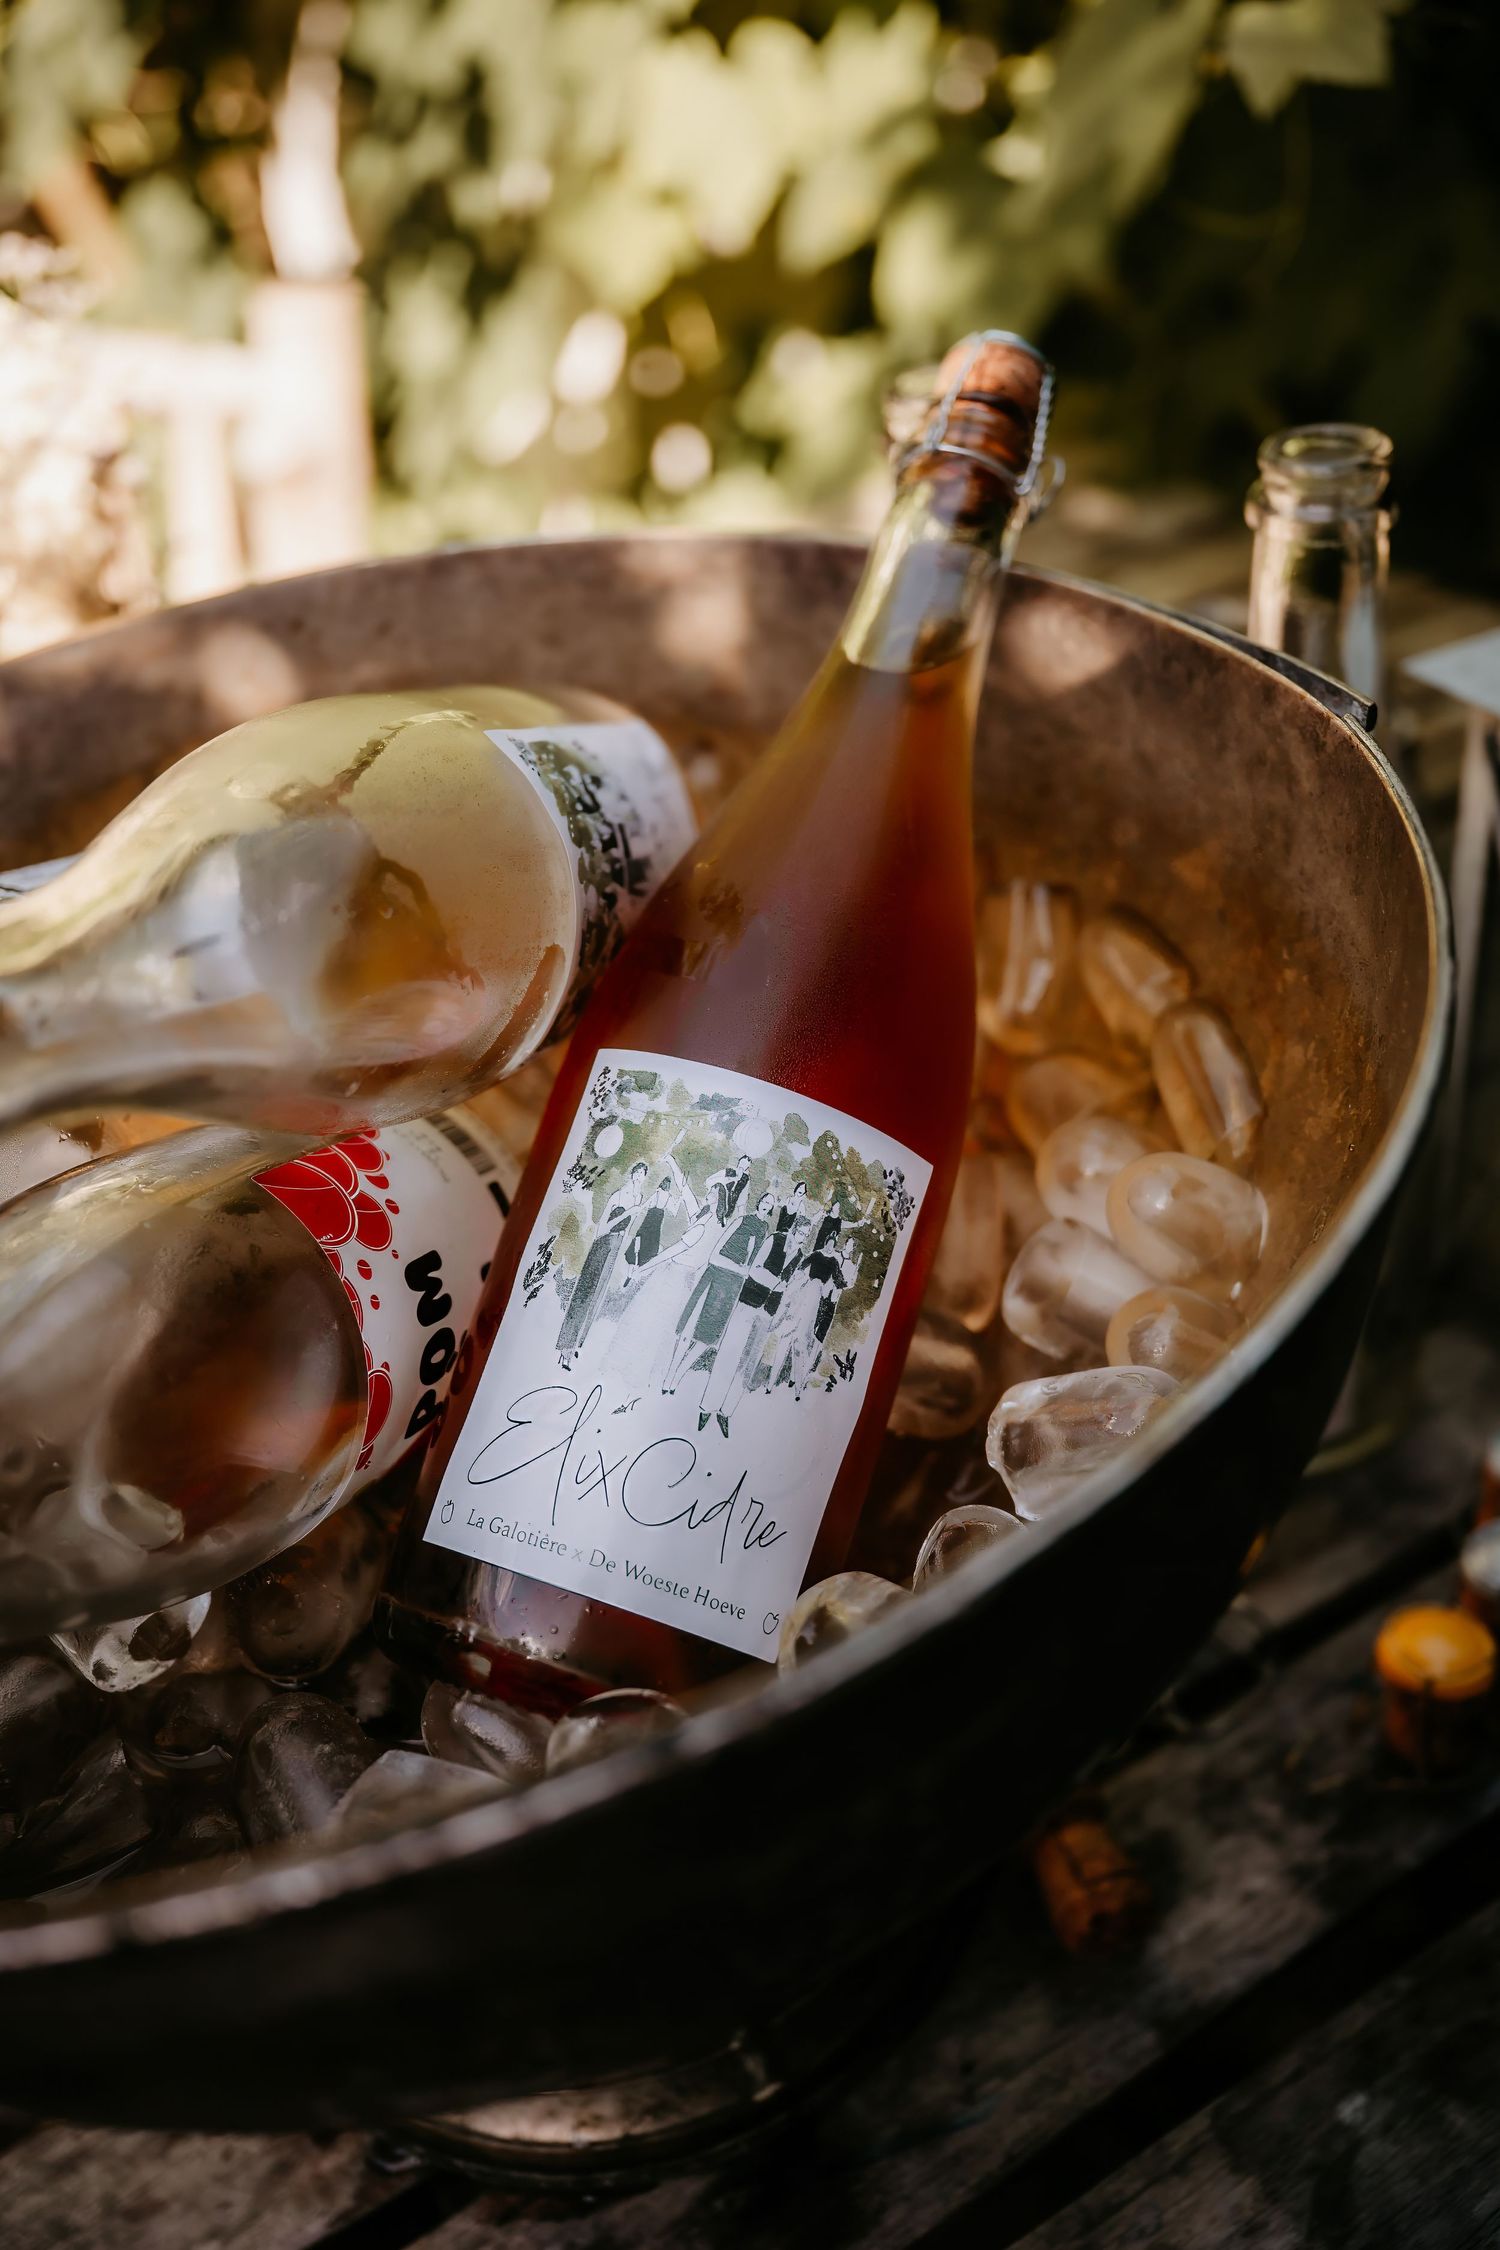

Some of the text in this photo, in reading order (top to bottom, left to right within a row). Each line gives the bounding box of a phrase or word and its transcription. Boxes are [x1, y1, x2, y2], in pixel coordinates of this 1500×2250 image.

[466, 1508, 484, 1530] La
[588, 1548, 618, 1574] De
[624, 1560, 690, 1600] Woeste
[693, 1586, 747, 1621] Hoeve
